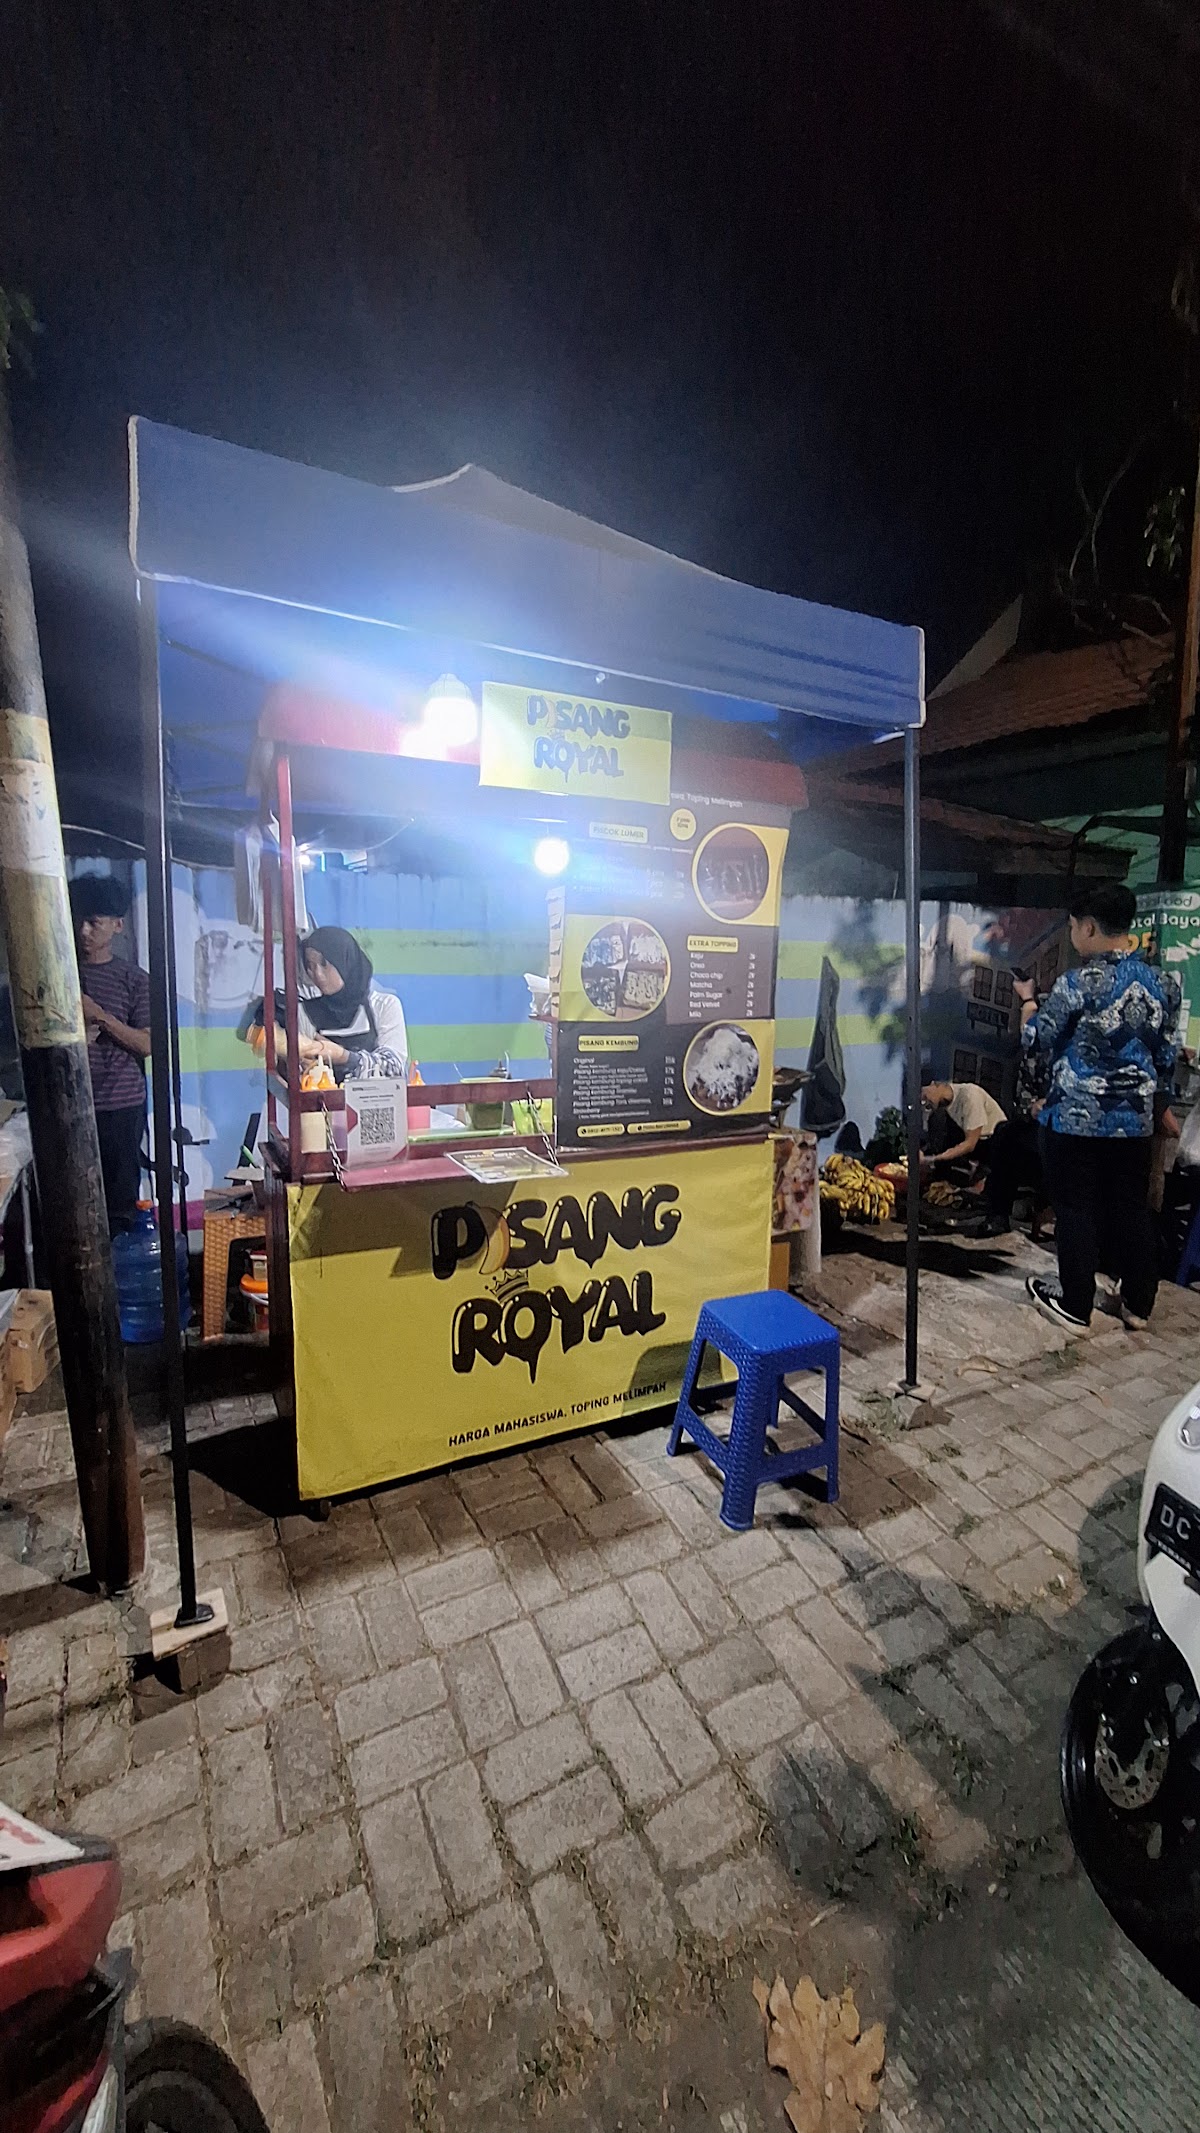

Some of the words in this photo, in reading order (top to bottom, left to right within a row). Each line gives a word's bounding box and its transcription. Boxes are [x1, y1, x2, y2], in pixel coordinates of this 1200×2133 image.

[534, 736, 625, 783] ROYAL
[593, 826, 619, 836] PISCOK
[620, 828, 645, 839] LUMER
[705, 991, 723, 1000] Sugar
[452, 1270, 666, 1384] ROYAL
[448, 1429, 490, 1447] HARGA
[571, 1396, 609, 1415] TOPING
[613, 1381, 666, 1403] MELIMPAH
